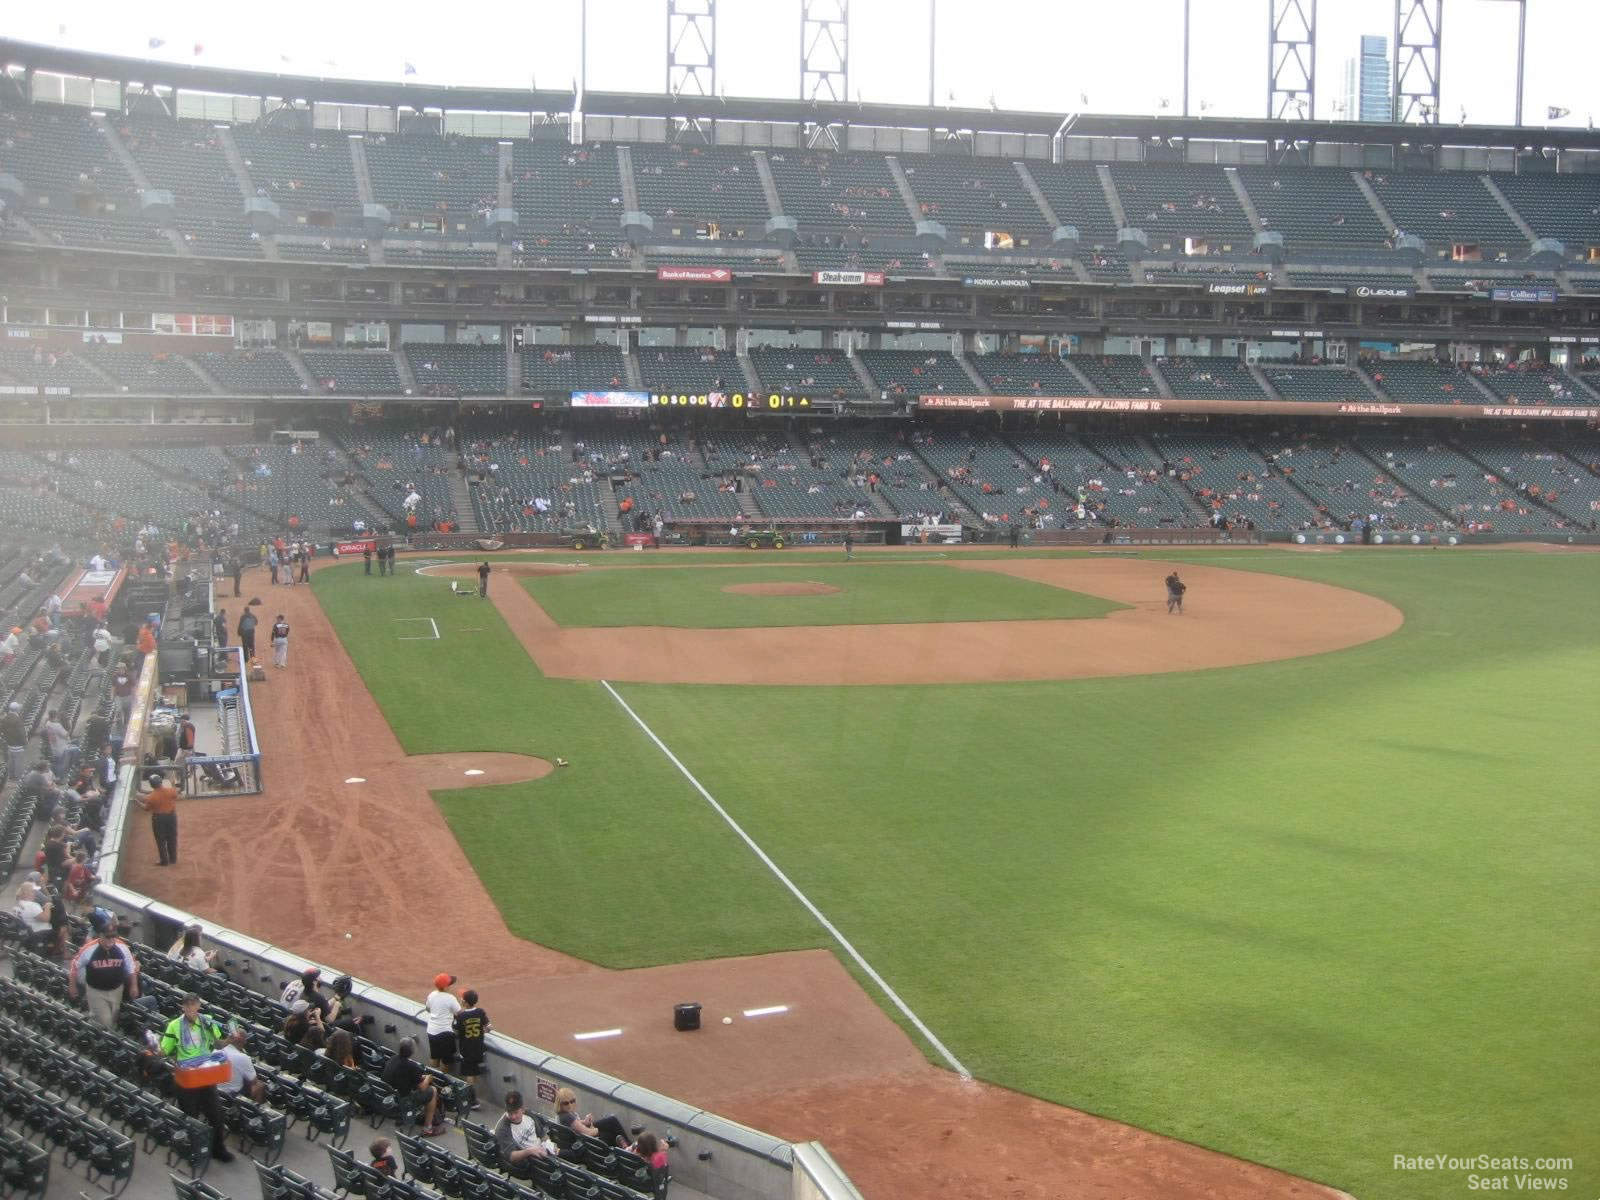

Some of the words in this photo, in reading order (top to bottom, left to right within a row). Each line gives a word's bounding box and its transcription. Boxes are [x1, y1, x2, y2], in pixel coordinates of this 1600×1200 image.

[822, 272, 862, 282] Steak-umm
[1209, 284, 1245, 294] Leapset
[958, 398, 990, 408] Ballpark
[1014, 400, 1027, 408] THE
[1027, 400, 1037, 408] AT
[1039, 400, 1052, 408] THE
[1052, 400, 1087, 408] BALLPARK
[1087, 401, 1102, 409] APP
[1102, 401, 1130, 409] ALLOWS
[1131, 401, 1149, 410] FANS
[1150, 402, 1162, 410] TO:
[1370, 405, 1401, 414] Ballpark
[465, 1024, 480, 1038] 55
